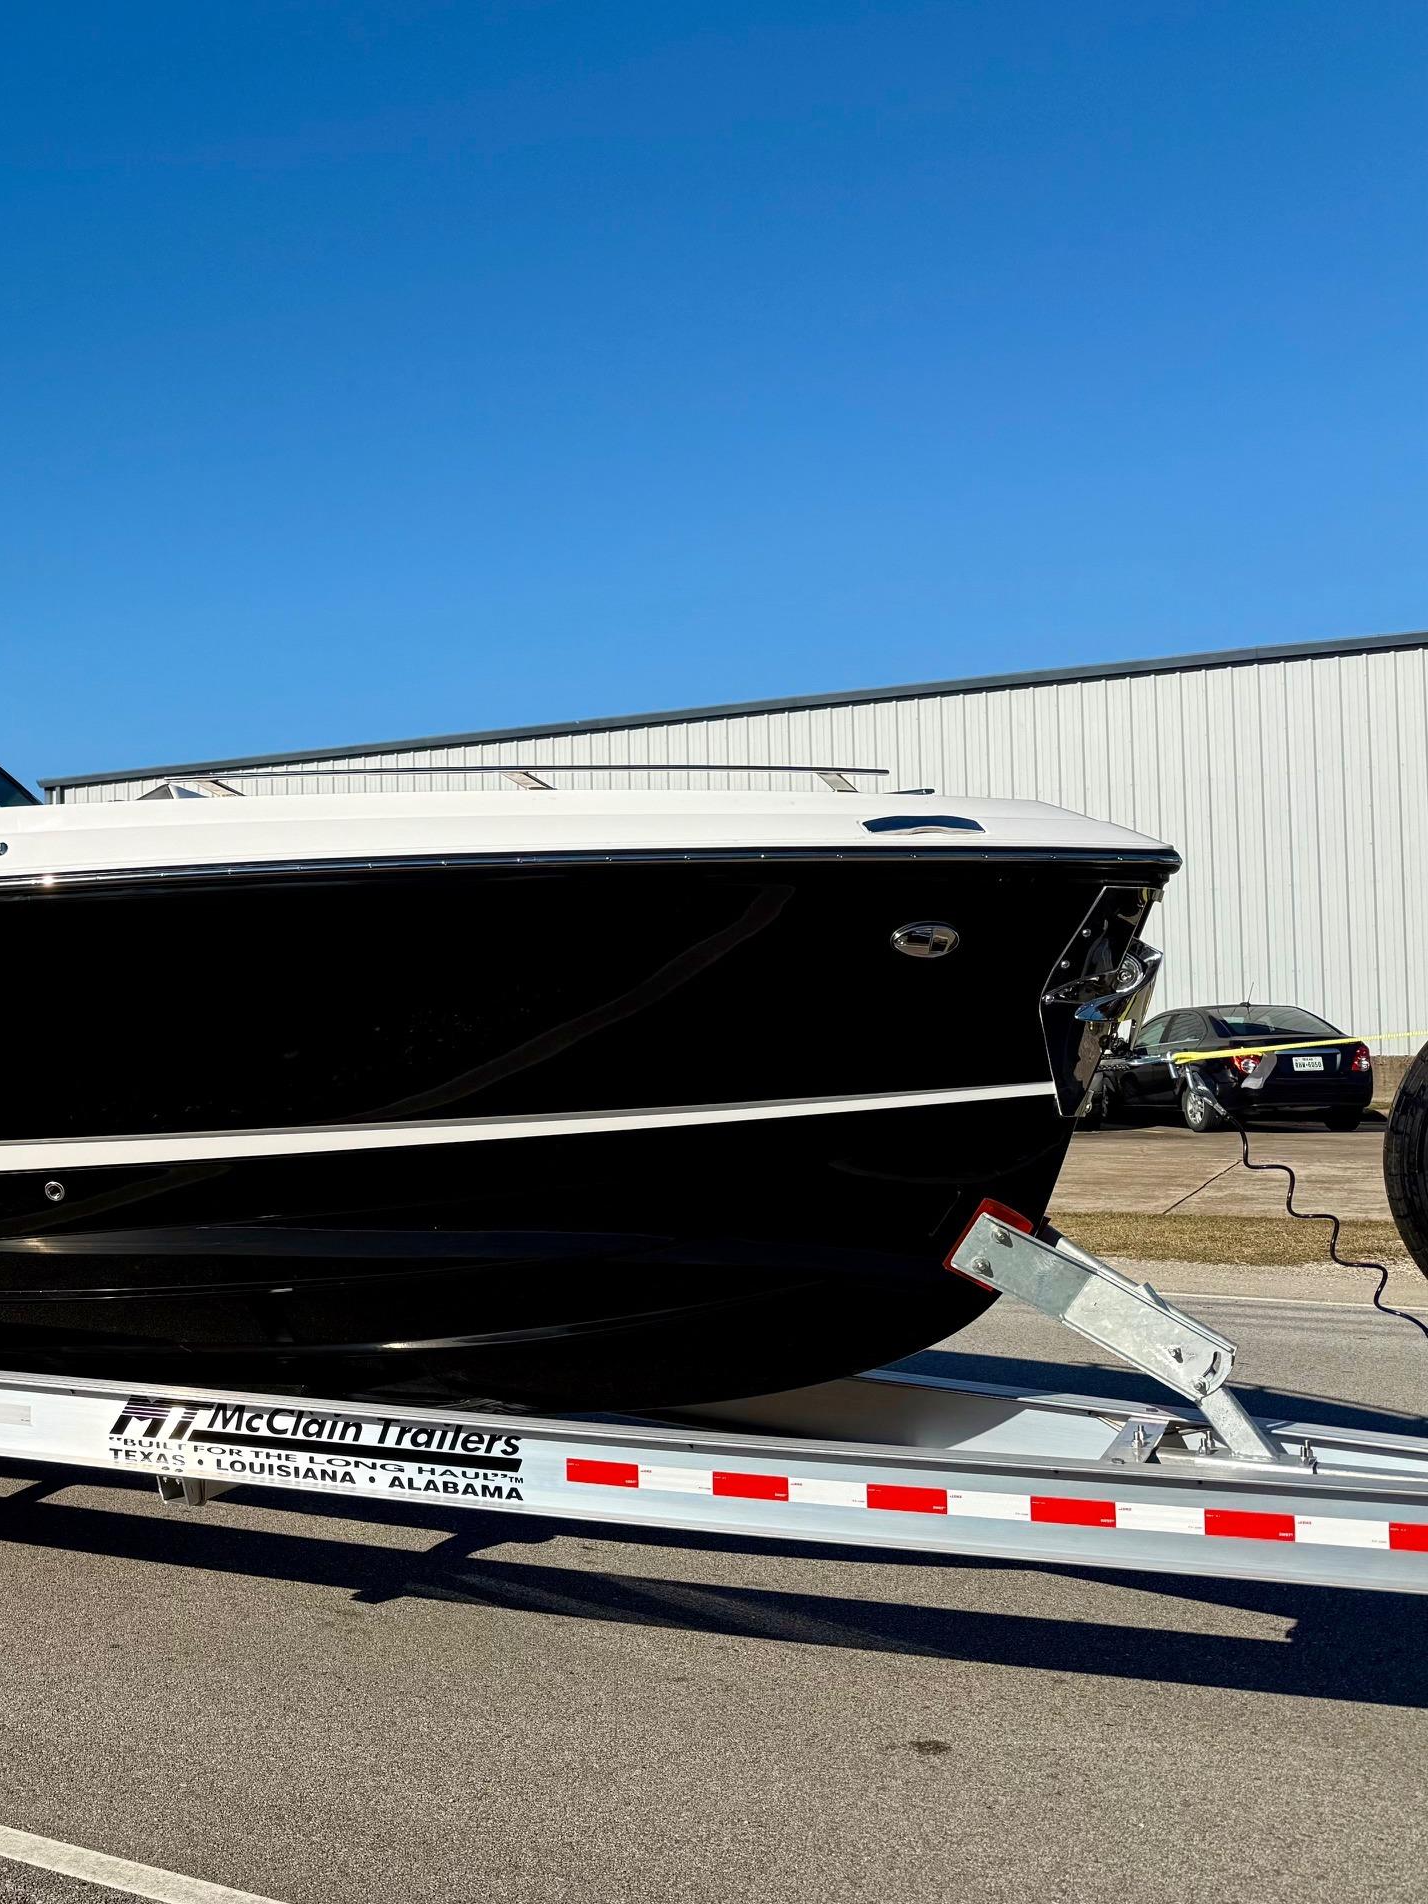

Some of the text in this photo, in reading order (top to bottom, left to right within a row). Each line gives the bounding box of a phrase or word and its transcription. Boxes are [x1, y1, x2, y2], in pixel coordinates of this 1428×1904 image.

[207, 1403, 523, 1457] McClain Trailers
[109, 1448, 524, 1501] TEXAS LOUISIANA ALABAMA
[193, 1444, 244, 1458] FOR
[250, 1449, 298, 1463] THE
[308, 1455, 406, 1474] LONG
